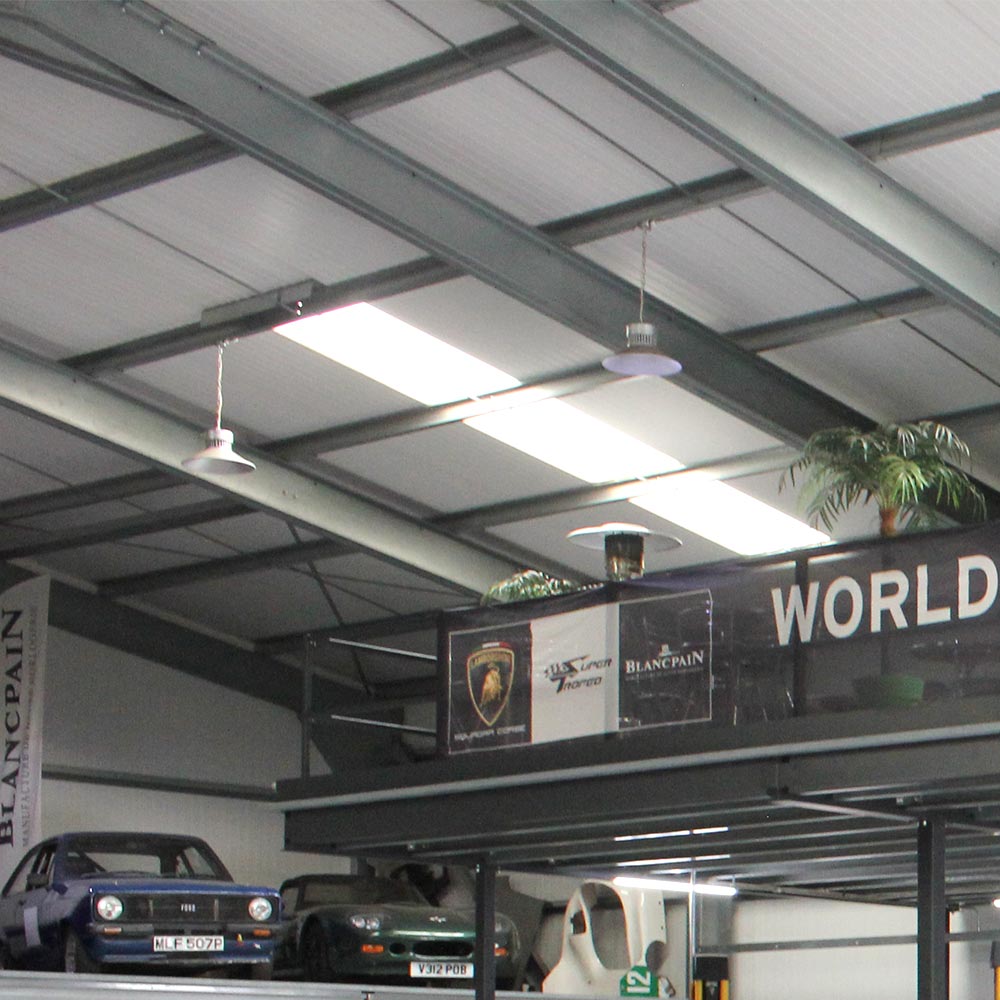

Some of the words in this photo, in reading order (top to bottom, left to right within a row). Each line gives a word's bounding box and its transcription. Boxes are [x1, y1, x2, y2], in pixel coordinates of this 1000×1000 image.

[771, 555, 998, 646] WORLD
[625, 650, 704, 674] BLANCPAIN
[0, 608, 23, 845] BLANCPAIN
[155, 937, 183, 950] MLF
[186, 937, 223, 950] 507P
[418, 963, 443, 974] V312
[445, 964, 467, 975] POB
[626, 970, 651, 993] 12
